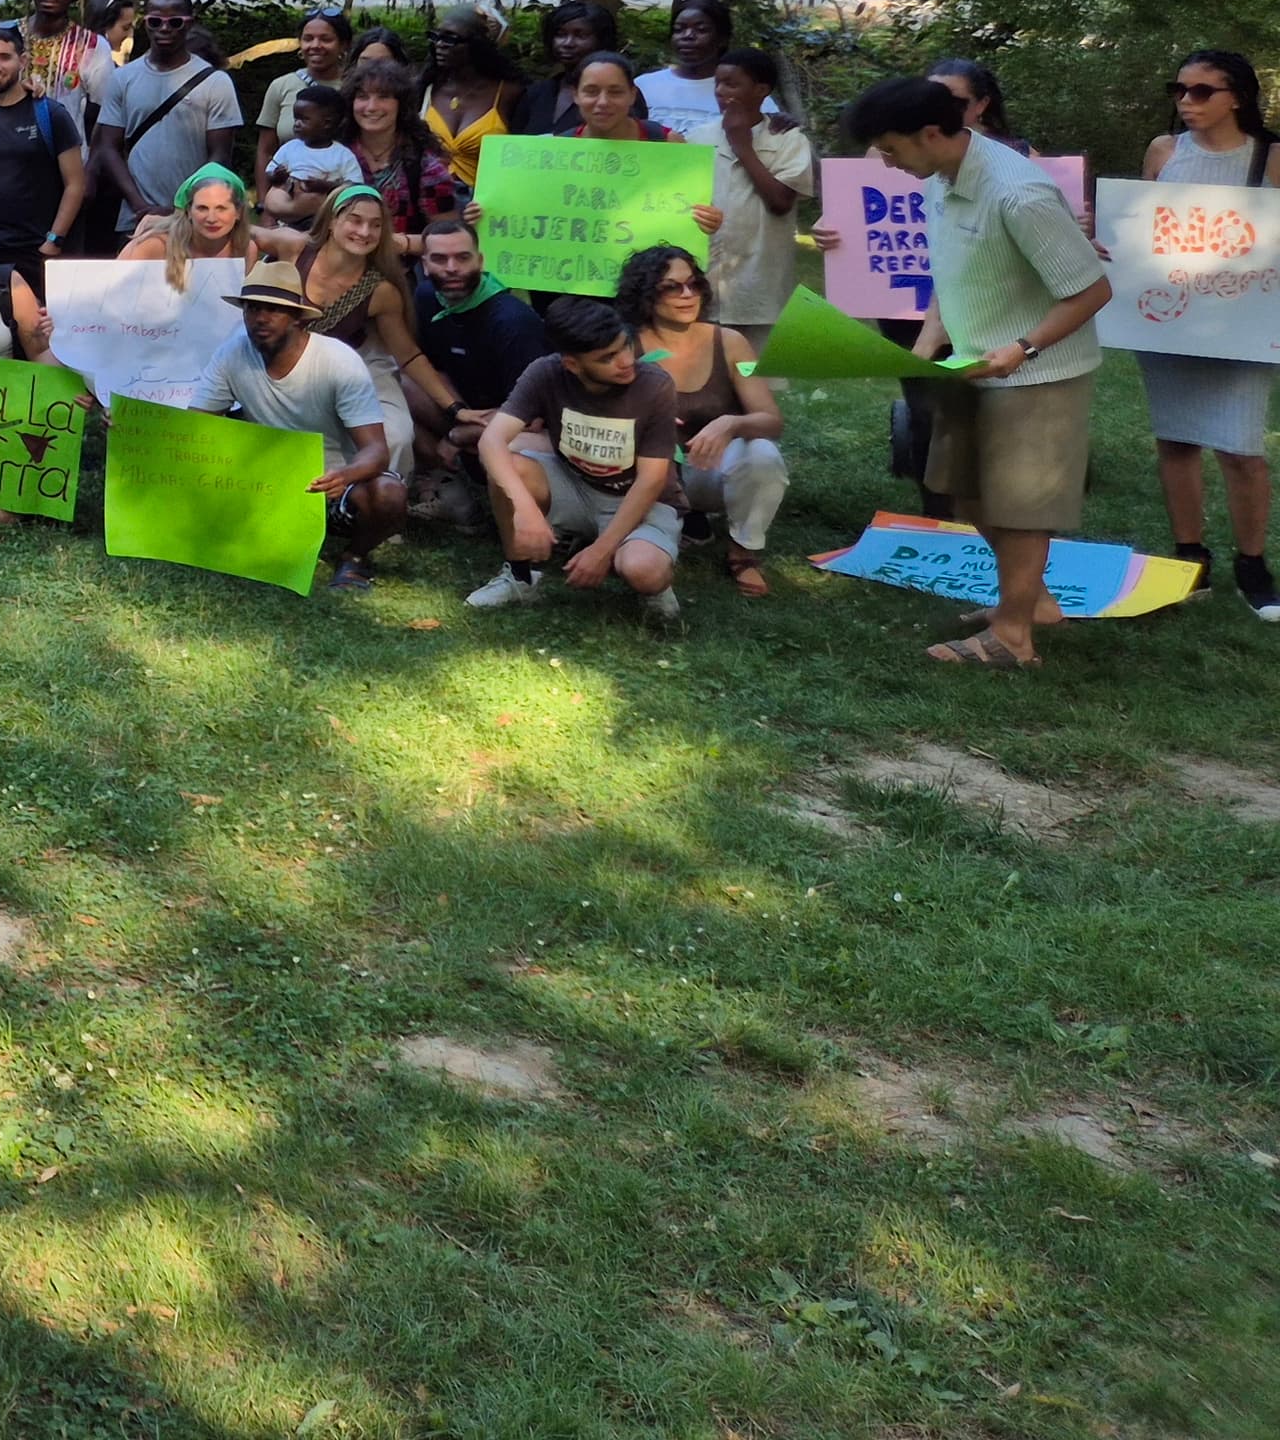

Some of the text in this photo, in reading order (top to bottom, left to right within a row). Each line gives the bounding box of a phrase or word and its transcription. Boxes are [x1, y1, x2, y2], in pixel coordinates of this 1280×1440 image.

[500, 142, 641, 177] DERECHOS
[562, 183, 623, 210] PARA
[861, 185, 927, 226] DER
[488, 215, 635, 245] MUJERES
[866, 229, 929, 252] PARA
[1151, 205, 1257, 259] NO
[869, 254, 931, 274] REFU
[28, 373, 77, 435] La
[566, 422, 629, 445] SOUTHERN
[568, 436, 625, 460] COMFORT
